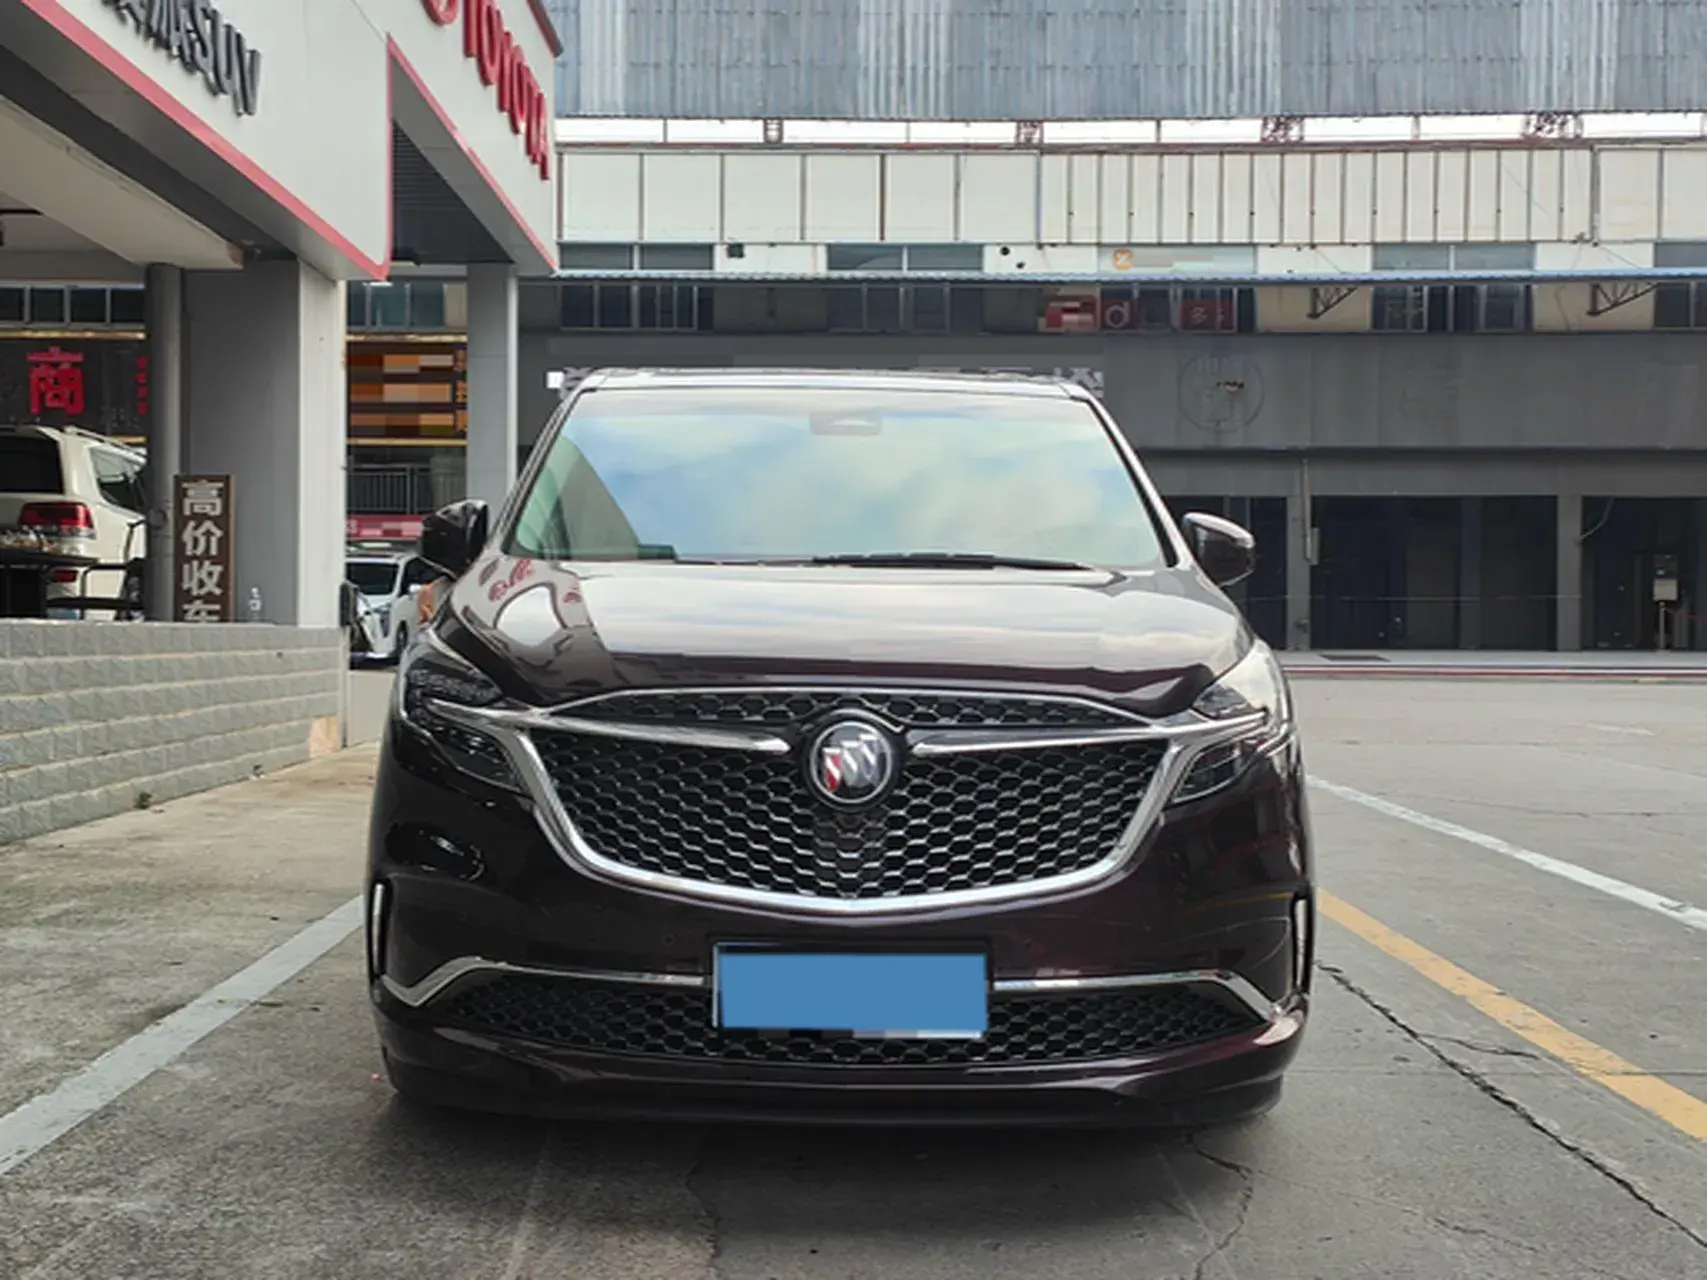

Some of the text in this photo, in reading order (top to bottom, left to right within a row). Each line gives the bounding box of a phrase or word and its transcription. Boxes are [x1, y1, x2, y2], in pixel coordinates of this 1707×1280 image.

[26, 345, 85, 416] 商
[181, 479, 224, 622] 高价收车
